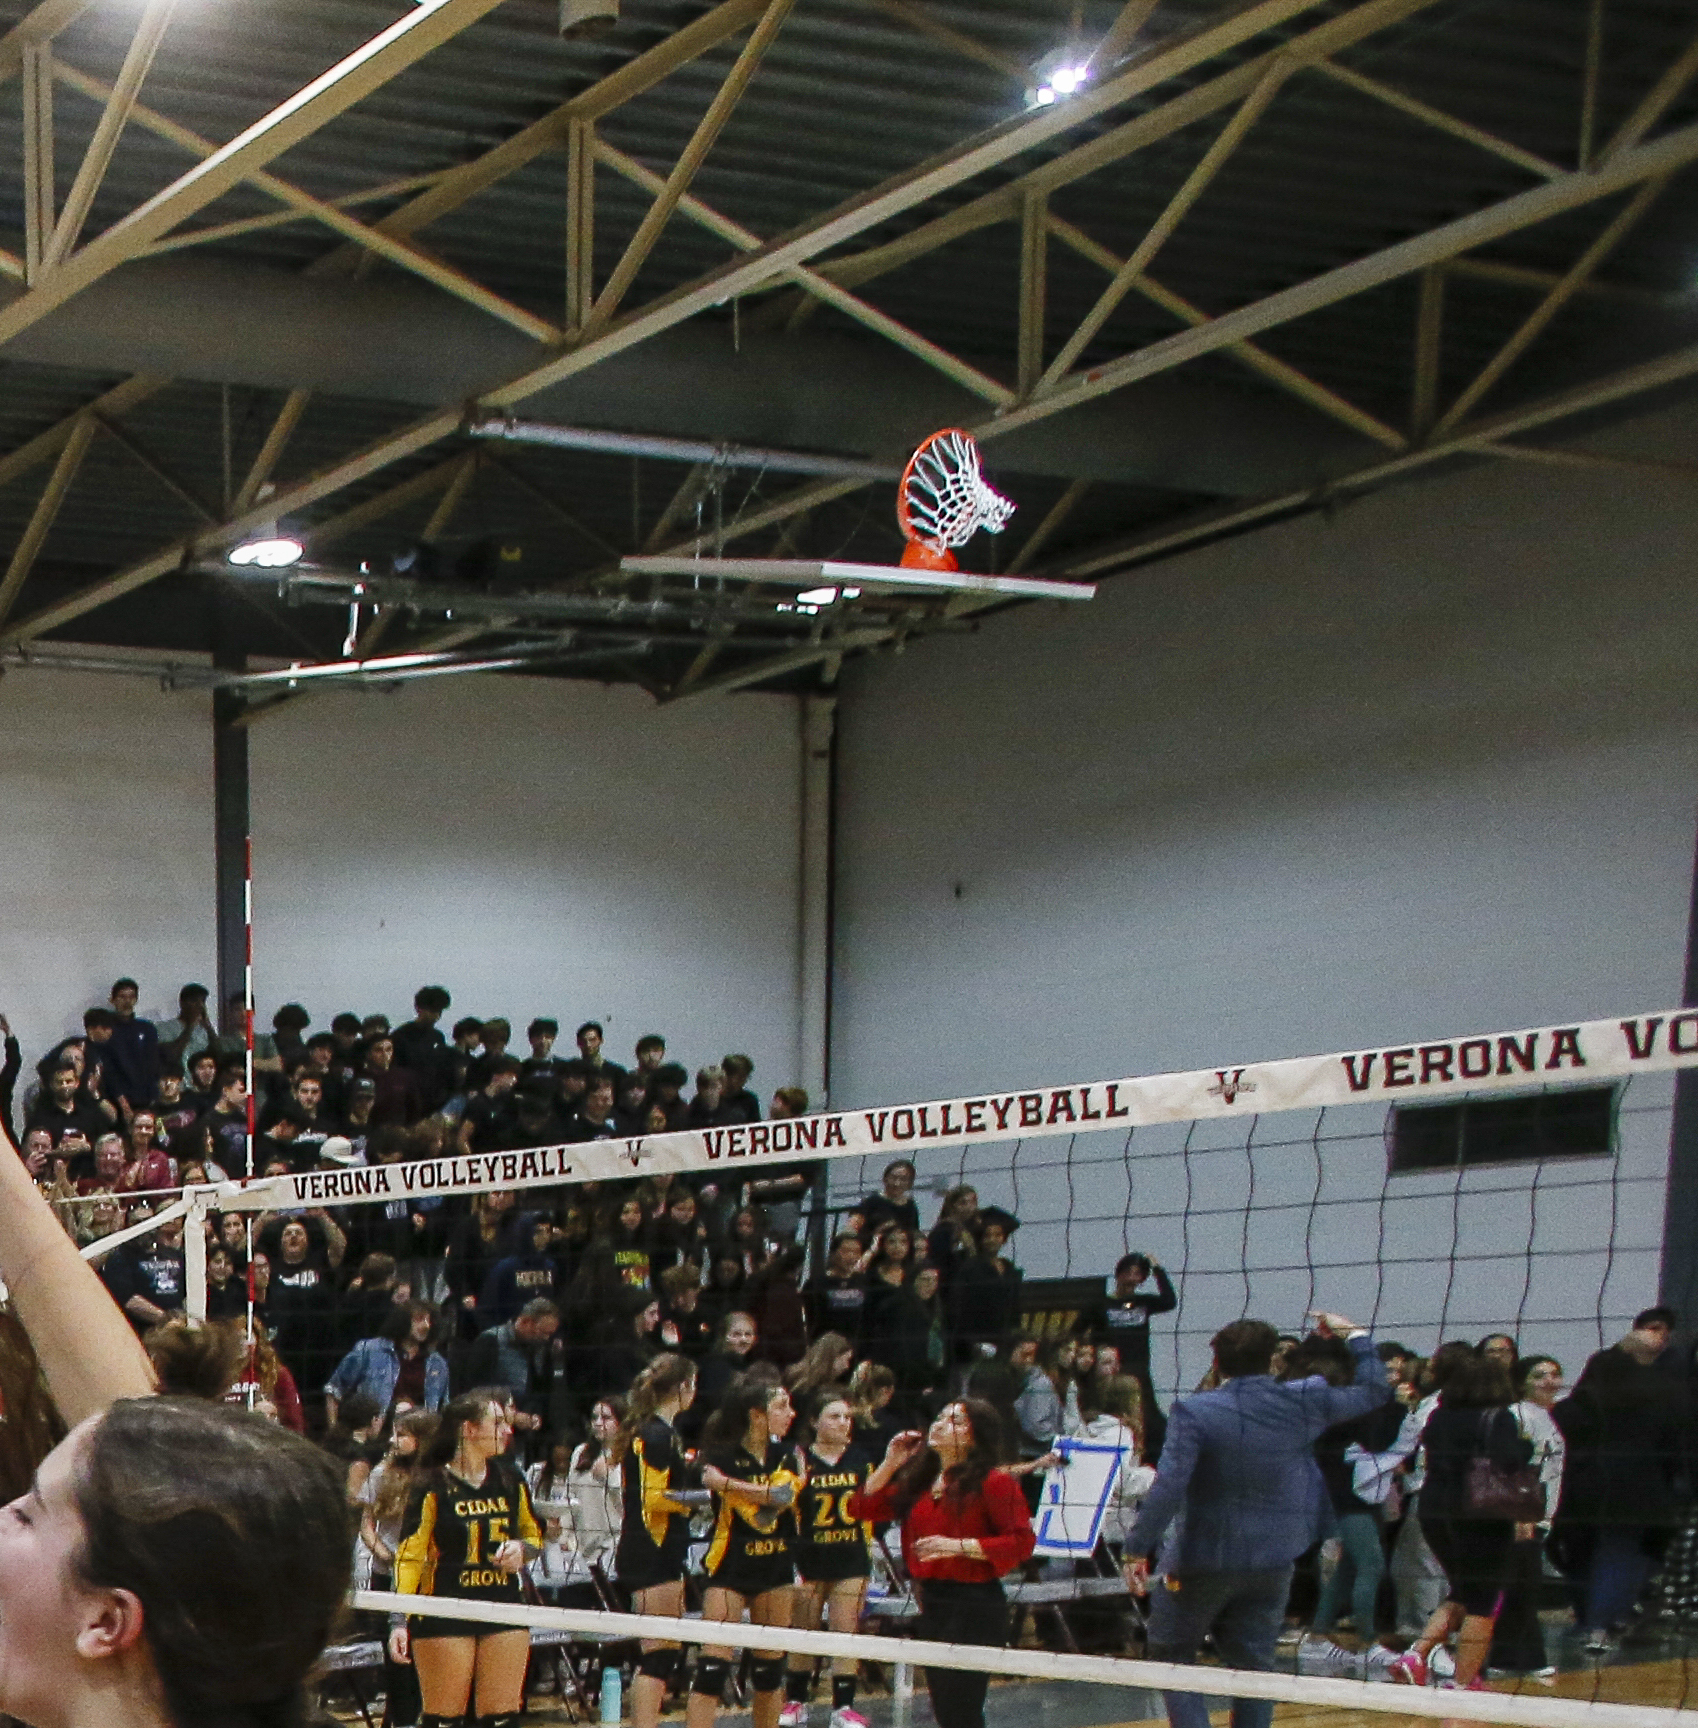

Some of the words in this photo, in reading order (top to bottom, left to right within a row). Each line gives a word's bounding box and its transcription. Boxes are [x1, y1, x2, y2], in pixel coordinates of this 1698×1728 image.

[1340, 1027, 1586, 1091] VERONA
[704, 1117, 846, 1159] VERONA
[865, 1084, 1129, 1142] VOLLEYBALL
[293, 1168, 392, 1200] VERONA
[401, 1148, 572, 1190] VOLLEYBALL
[811, 1472, 859, 1488] CEDAR
[454, 1496, 510, 1517] CEDAR
